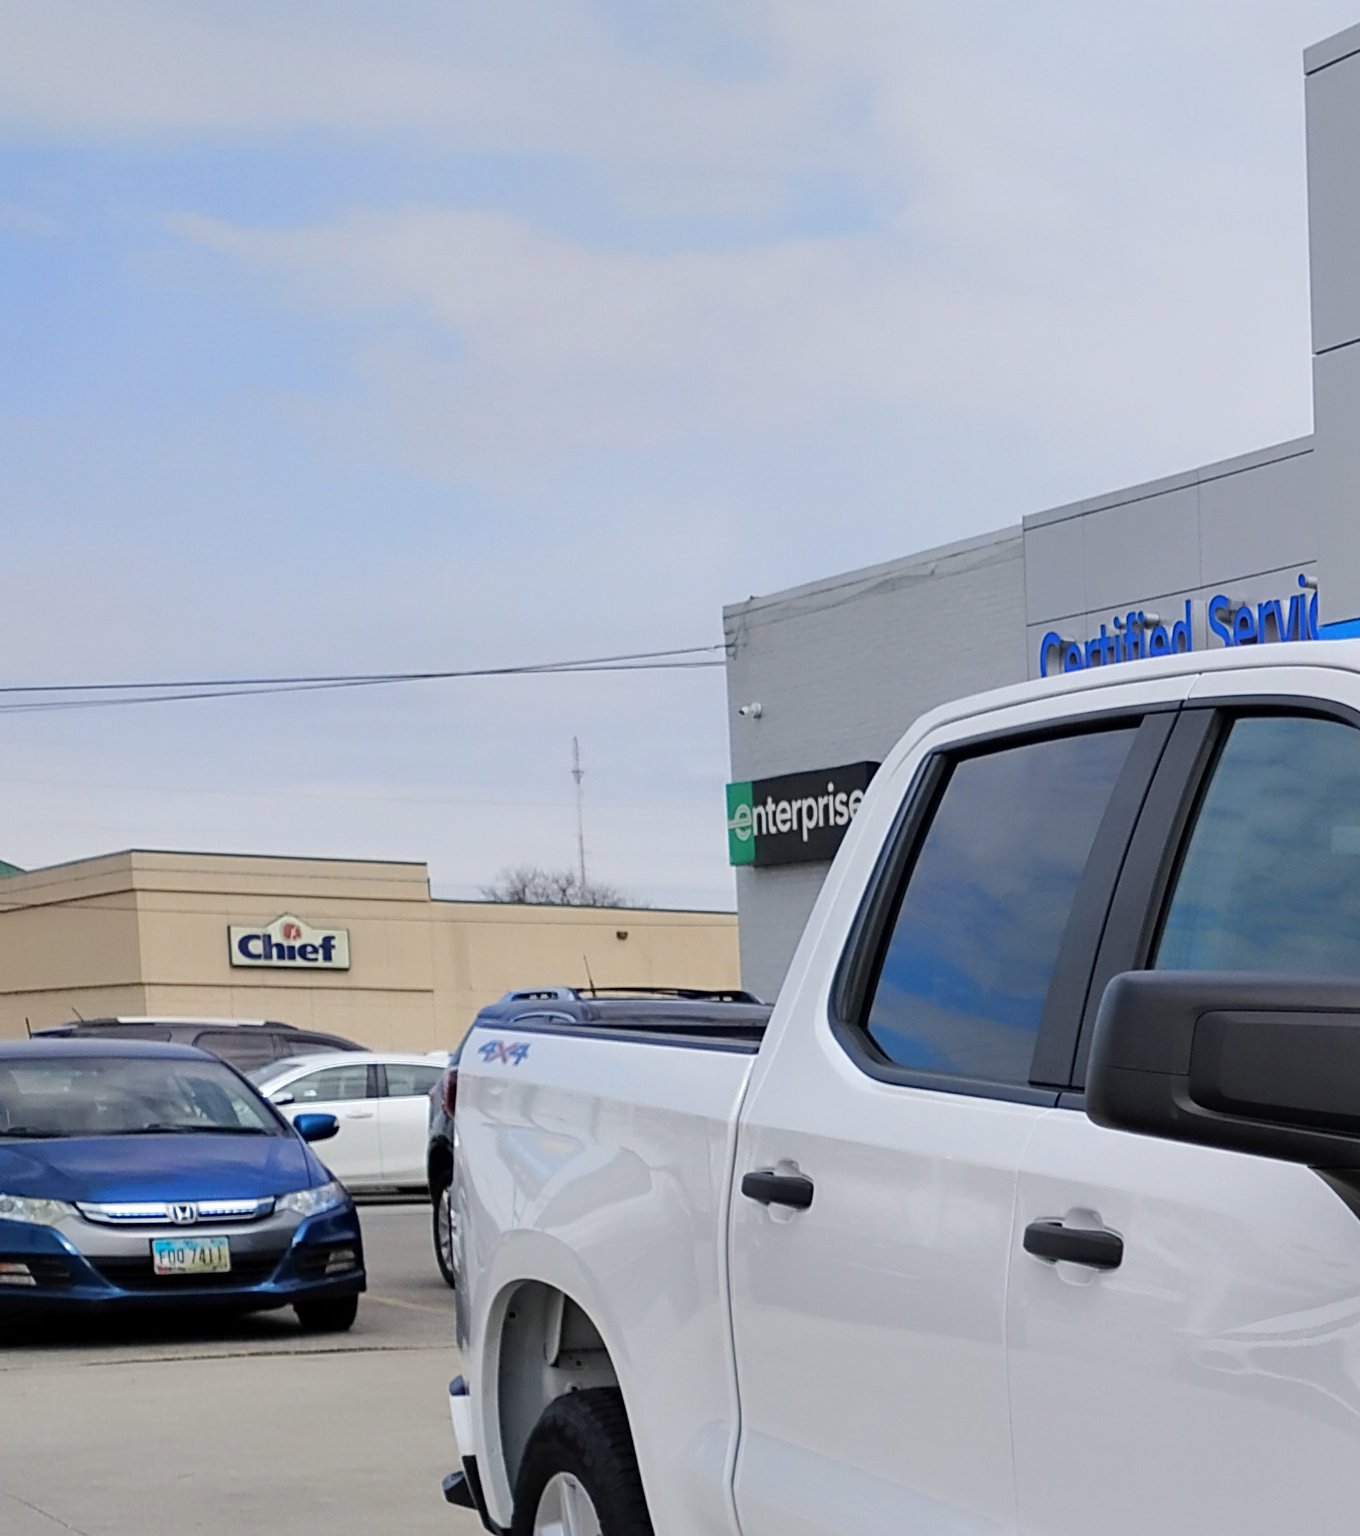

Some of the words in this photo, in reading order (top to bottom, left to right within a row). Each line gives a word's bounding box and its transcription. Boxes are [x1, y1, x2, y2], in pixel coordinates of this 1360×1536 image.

[1040, 599, 1193, 679] Certified
[728, 781, 866, 842] enterprise
[237, 933, 336, 963] Chief
